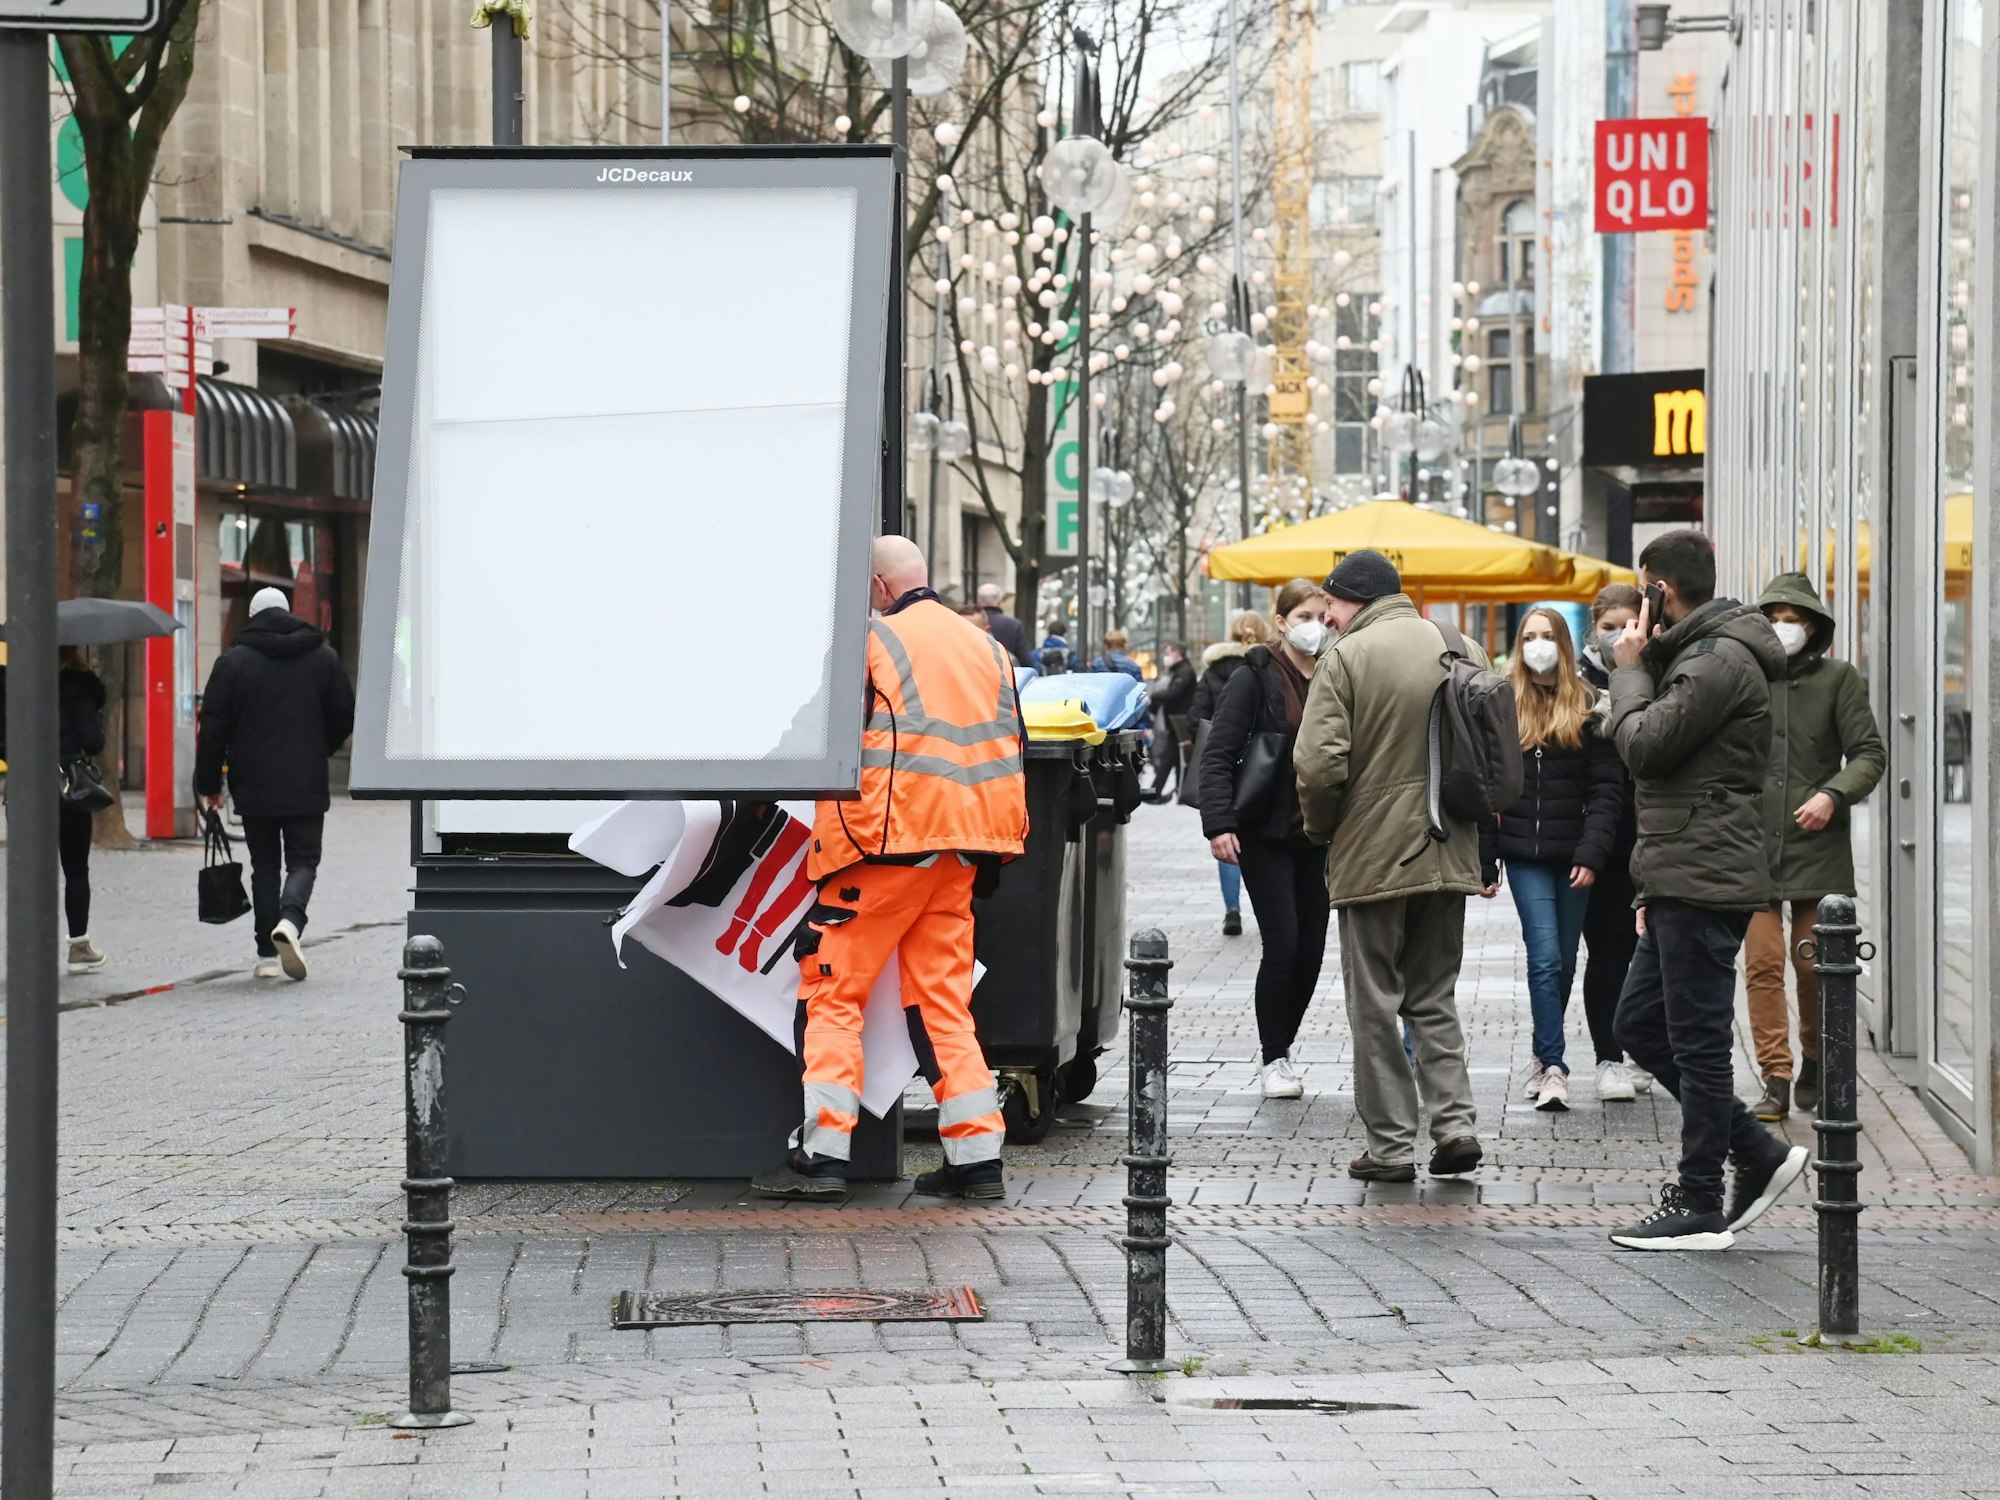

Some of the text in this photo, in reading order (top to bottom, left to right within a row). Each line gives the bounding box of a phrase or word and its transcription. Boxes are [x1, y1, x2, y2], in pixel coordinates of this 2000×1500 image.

[1606, 132, 1687, 172] UNI
[596, 167, 694, 182] JCDecaux
[1606, 178, 1695, 225] QLO
